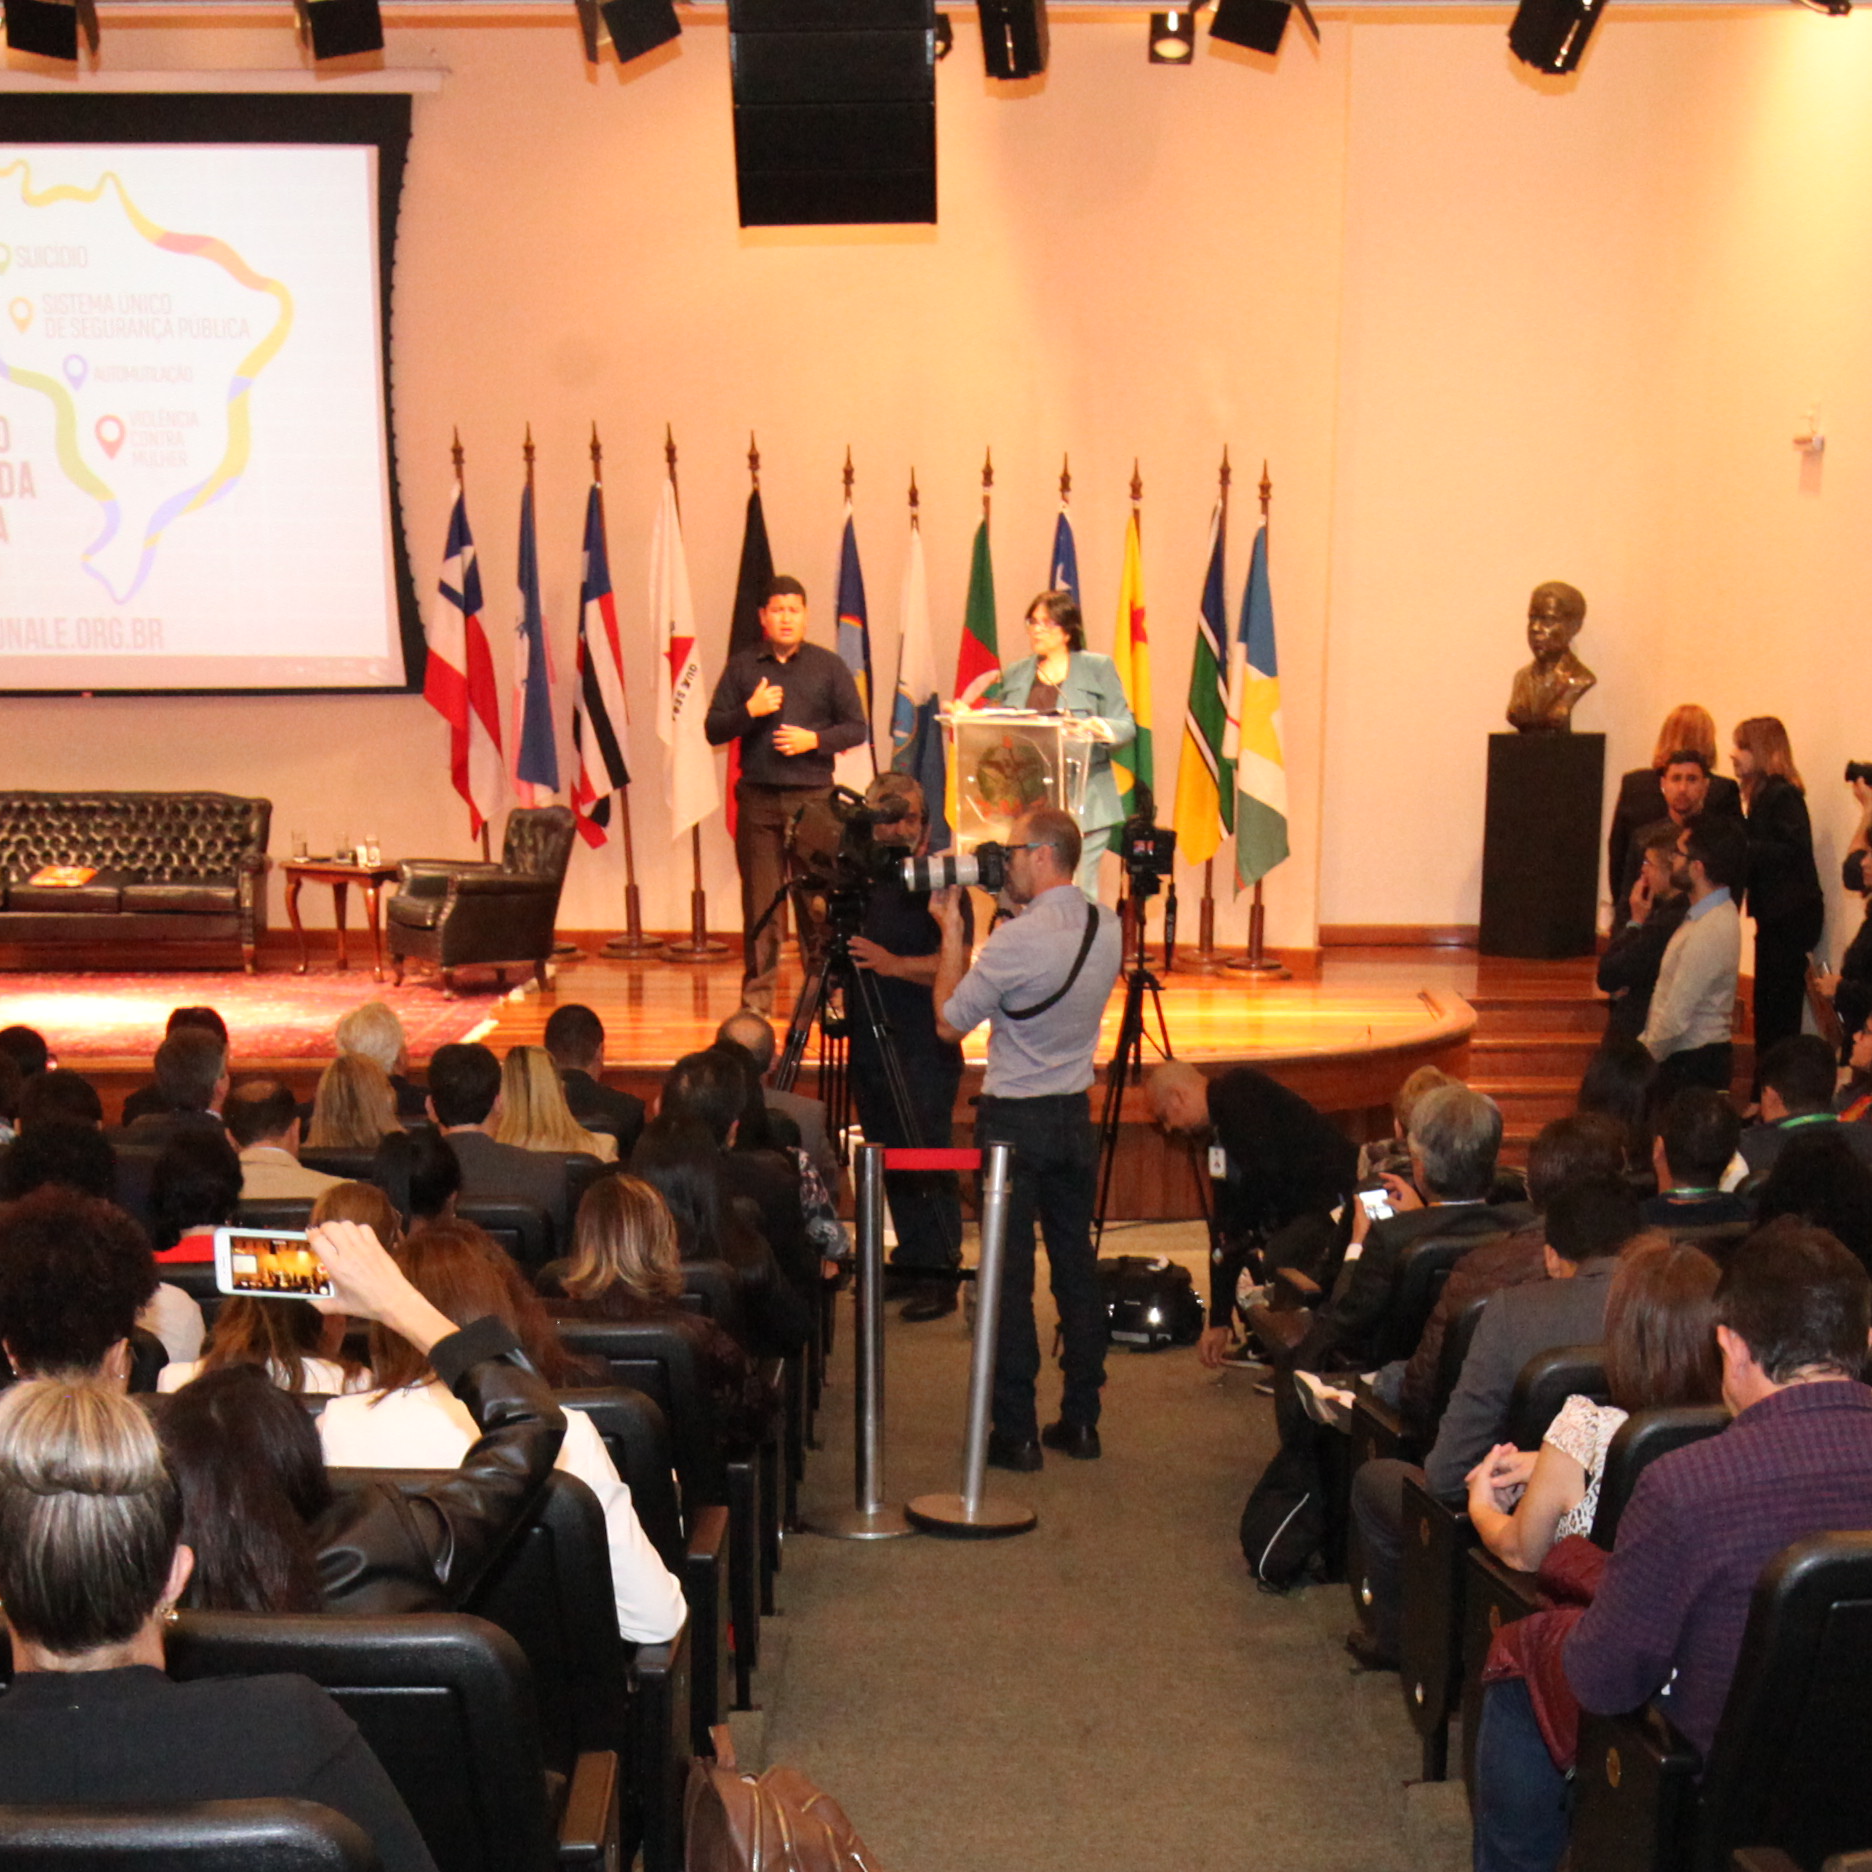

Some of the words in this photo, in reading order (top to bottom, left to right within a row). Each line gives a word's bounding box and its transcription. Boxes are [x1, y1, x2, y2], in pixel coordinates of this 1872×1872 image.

[43, 294, 114, 314] SISTEMA
[46, 318, 65, 338] DE
[70, 318, 173, 342] SEGURANÇA
